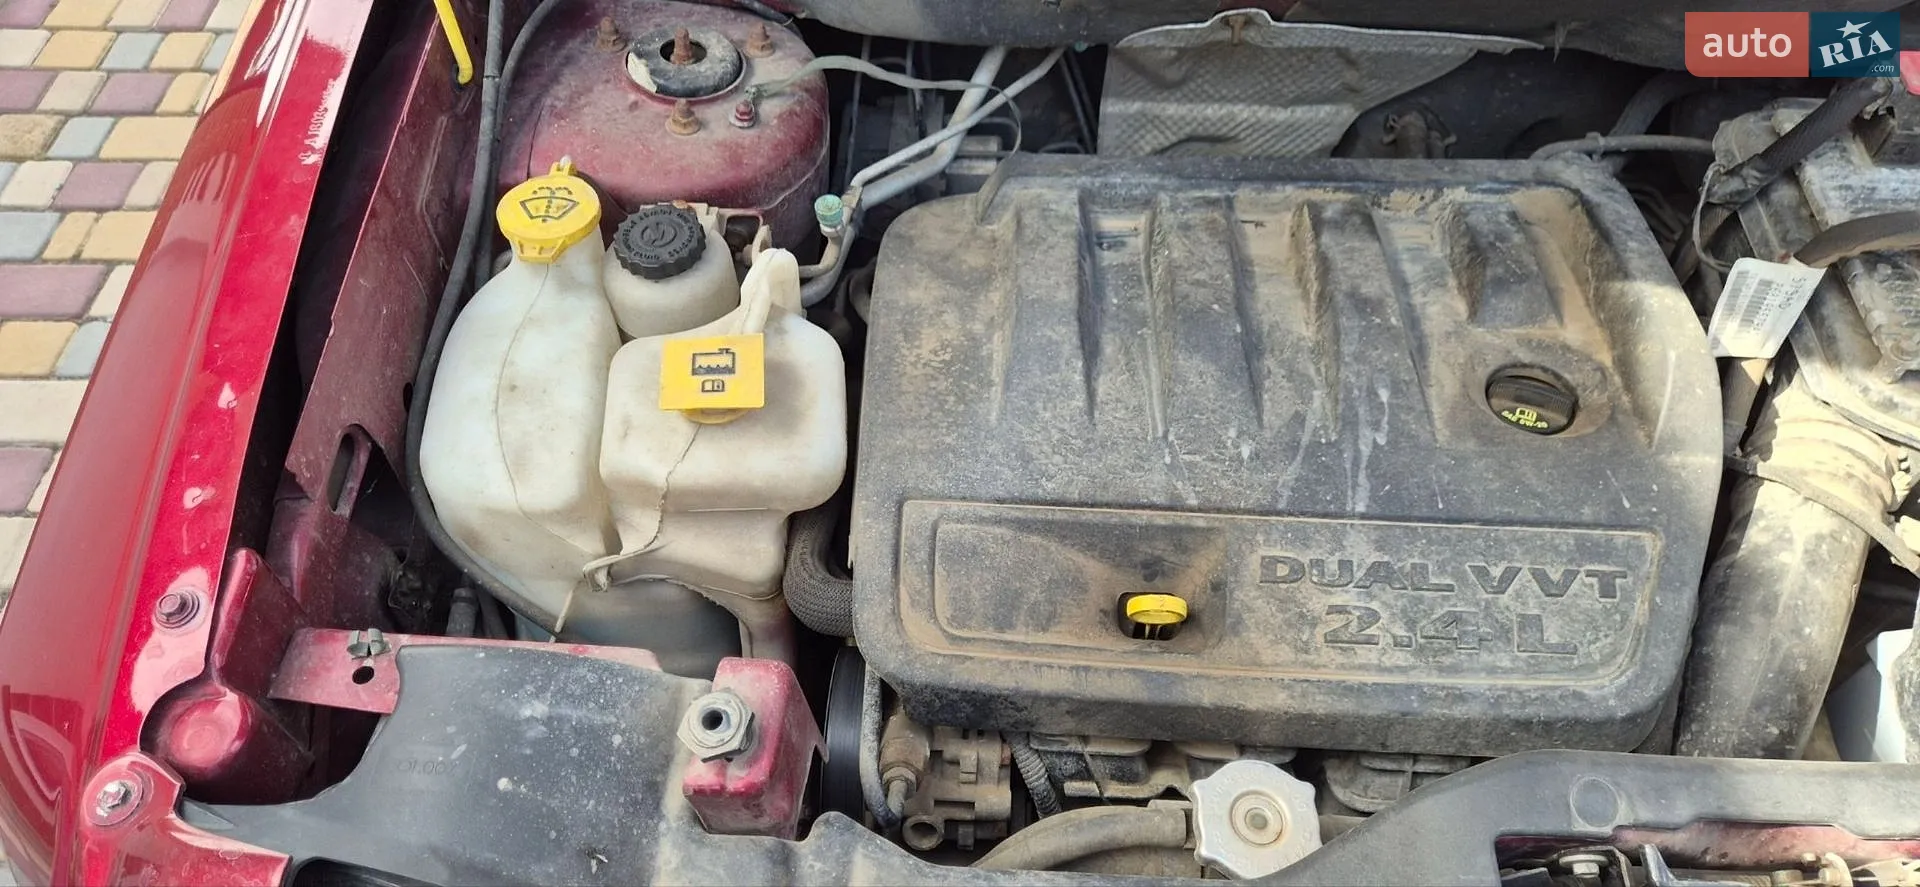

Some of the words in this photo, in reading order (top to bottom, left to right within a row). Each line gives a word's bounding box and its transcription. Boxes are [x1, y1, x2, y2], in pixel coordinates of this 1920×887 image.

[1258, 554, 1456, 593] DUAL
[1466, 562, 1629, 600] VVT
[1322, 603, 1495, 653] 2.4
[1514, 611, 1579, 656] L
